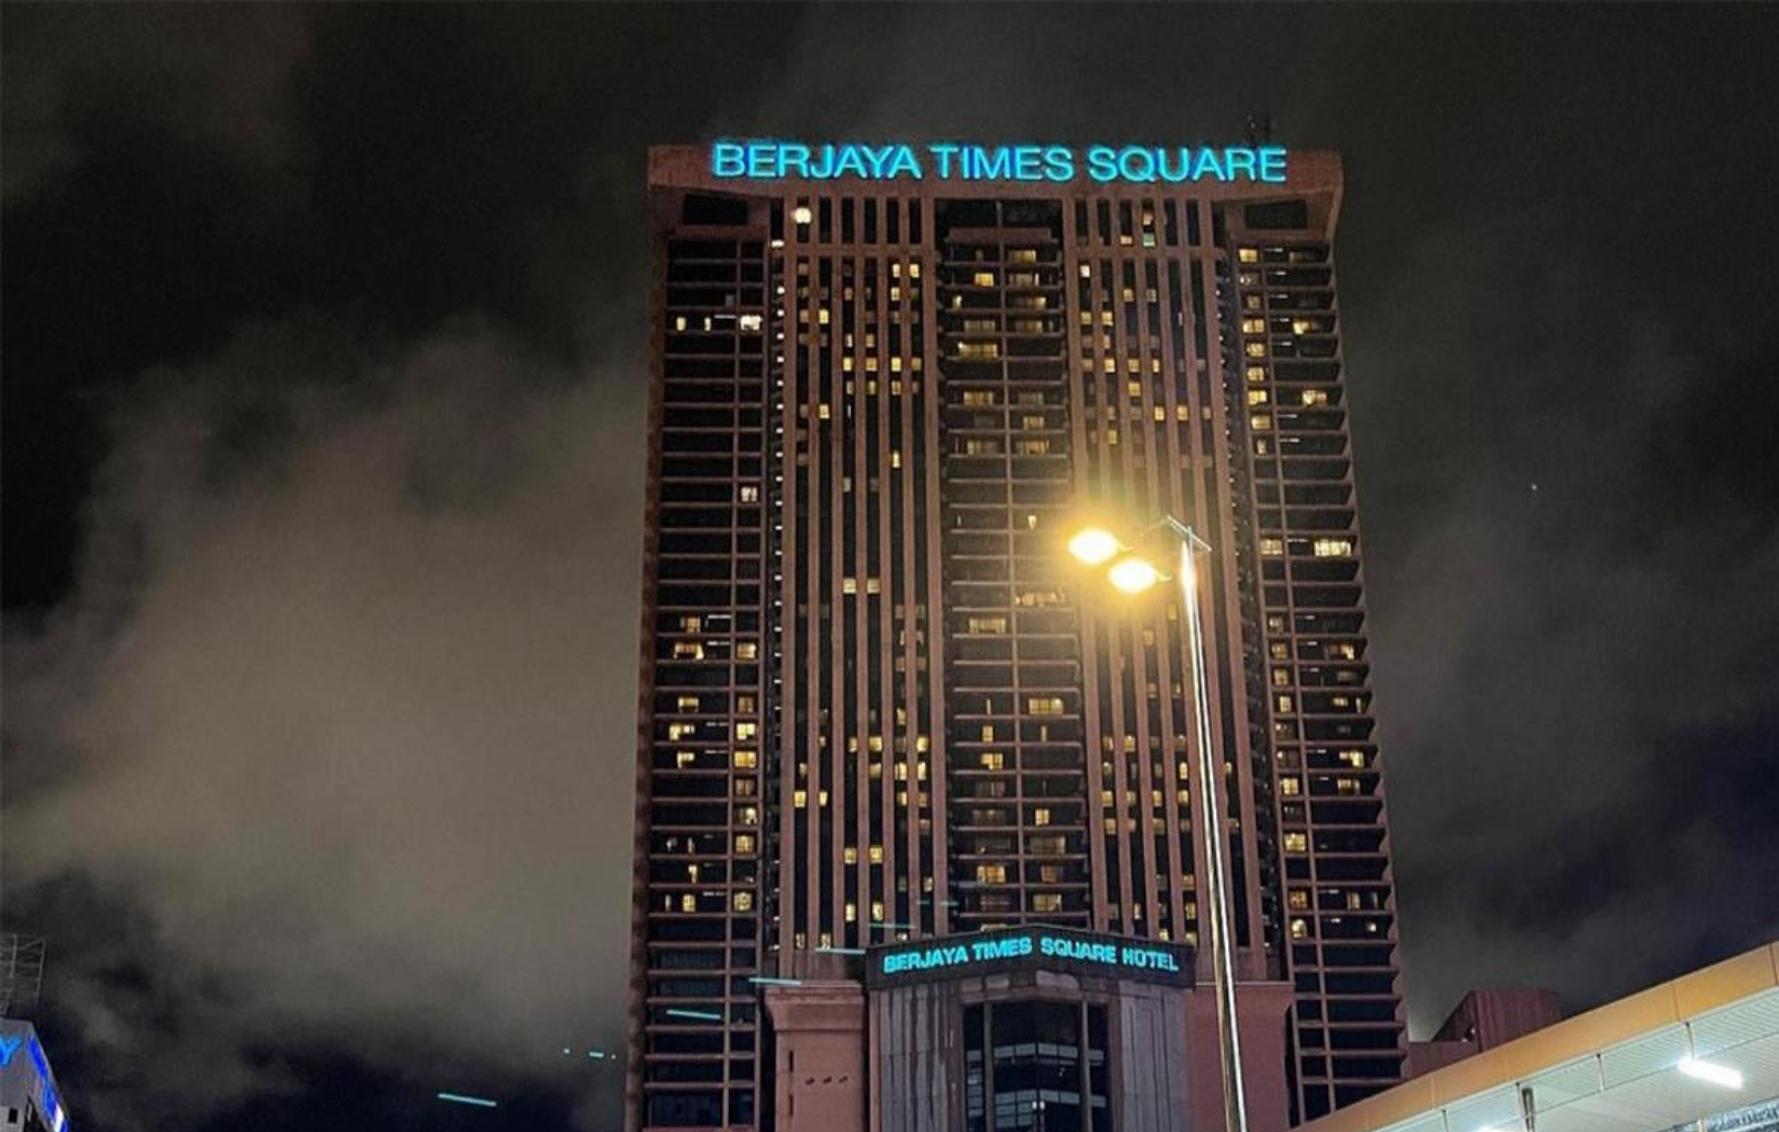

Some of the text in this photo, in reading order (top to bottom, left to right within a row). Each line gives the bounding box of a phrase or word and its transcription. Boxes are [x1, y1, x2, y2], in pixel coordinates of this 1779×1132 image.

[712, 142, 1287, 183] BERJAYA TIMES SQUARE
[883, 936, 1180, 974] BERJAYA TIMES SQUARE HOTEL
